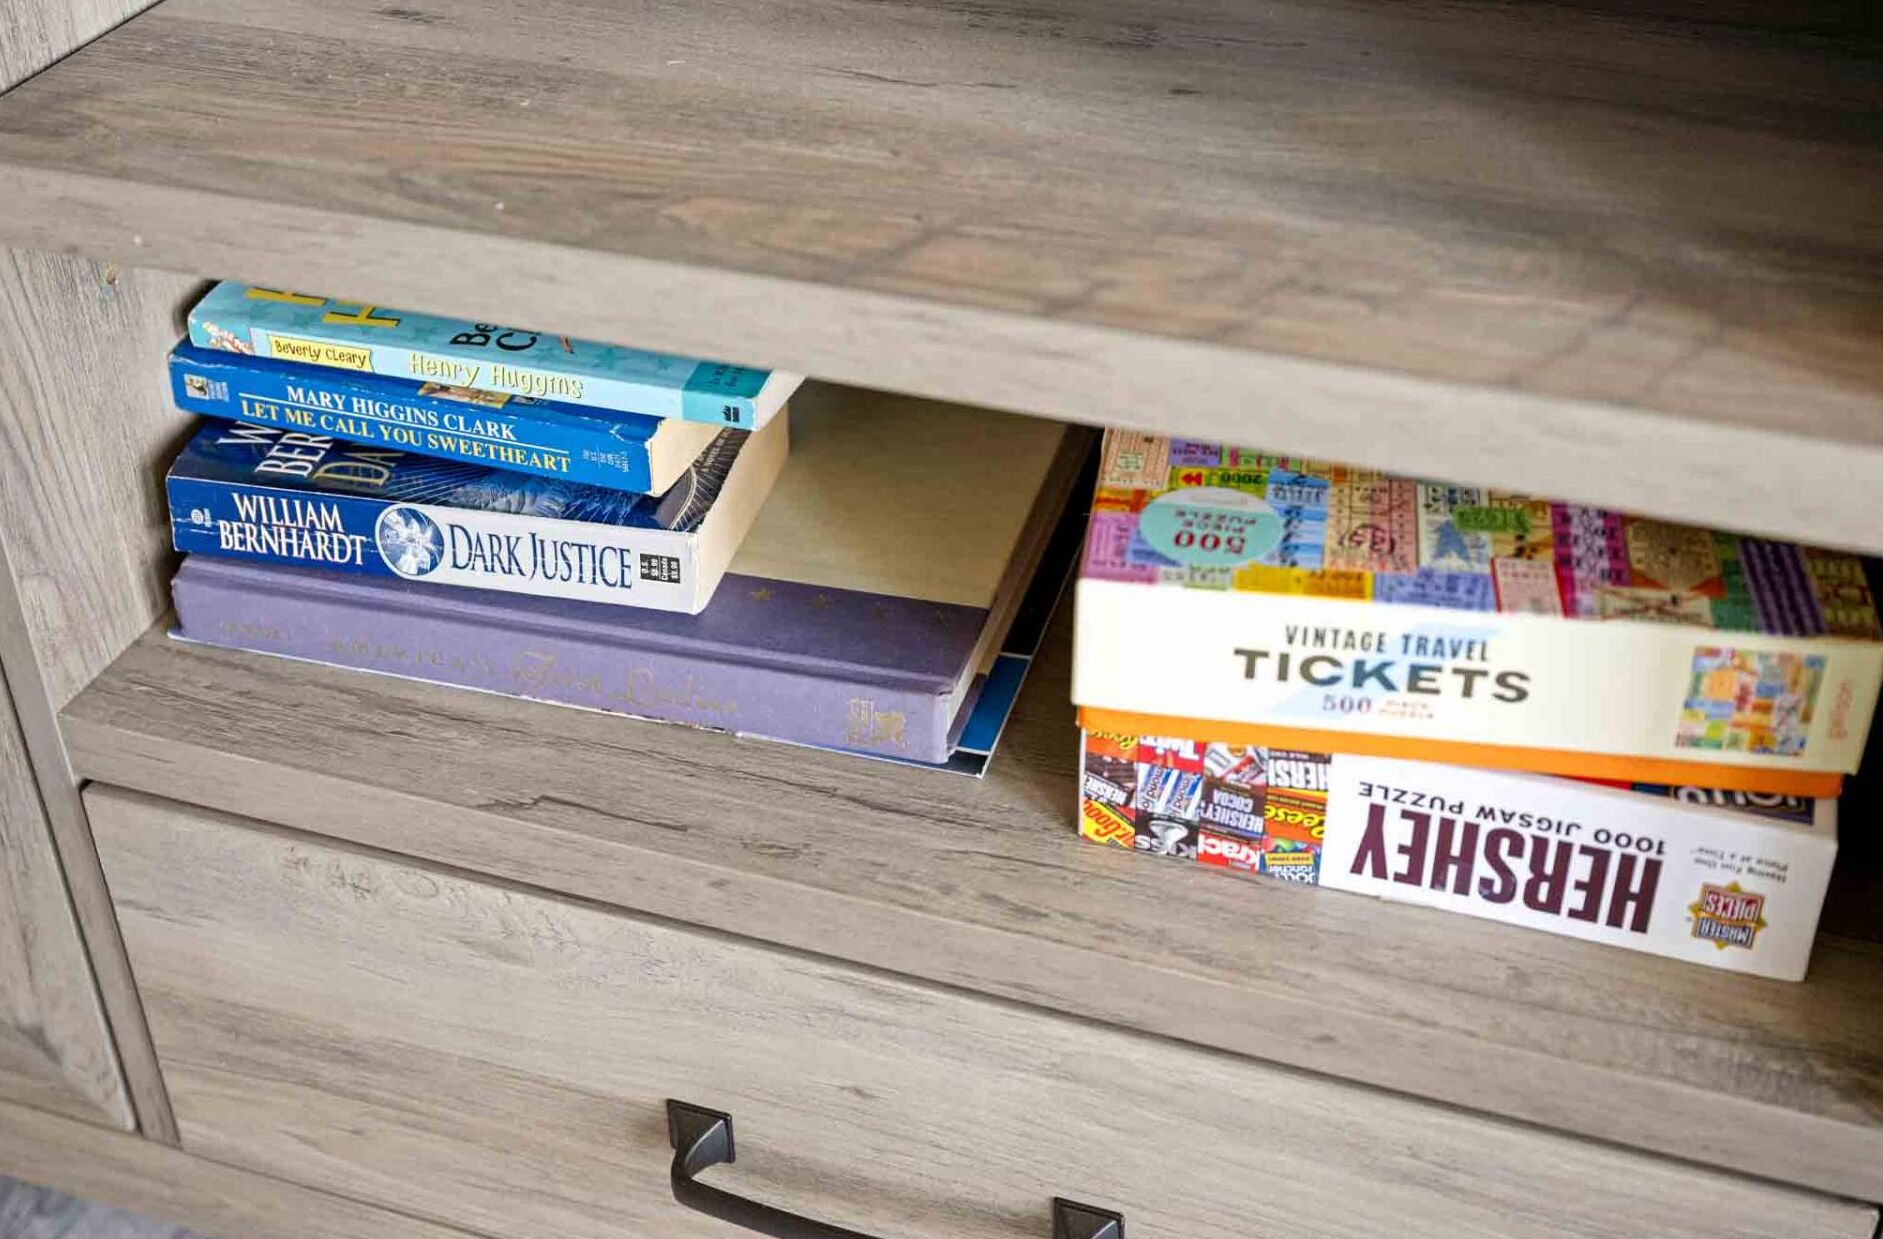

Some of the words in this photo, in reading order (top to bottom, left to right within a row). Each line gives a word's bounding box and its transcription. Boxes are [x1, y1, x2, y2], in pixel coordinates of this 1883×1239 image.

[274, 338, 322, 362] Beverly
[325, 348, 368, 369] Cleary
[410, 352, 481, 387] Henry
[489, 365, 585, 399] Huggins
[287, 386, 346, 410] MARY
[351, 391, 440, 426] HIGGINS
[443, 414, 517, 442] CLARK
[240, 400, 281, 421] LET
[284, 406, 317, 428] ME
[320, 414, 375, 439] CALL
[379, 424, 424, 447] YOU
[427, 430, 571, 474] SWEETHEART
[231, 492, 345, 534] WILLIAM
[218, 519, 367, 566] BERNHARDT
[447, 523, 527, 577] DARK
[528, 531, 633, 590] JUSTICE
[1173, 530, 1247, 555] 500
[1285, 624, 1387, 654] VINTAGE
[1401, 633, 1490, 662] TRAVEL
[1233, 648, 1532, 704] TICKETS
[1322, 693, 1372, 714] 500
[1213, 789, 1253, 813] COCOA
[1358, 781, 1465, 815] PUZZLE
[1475, 804, 1582, 837] JIGSAW
[1593, 827, 1667, 857] 1000
[1349, 802, 1664, 935] HERSHEY
[1705, 893, 1757, 922] PIECES
[1700, 917, 1751, 945] MASTER
